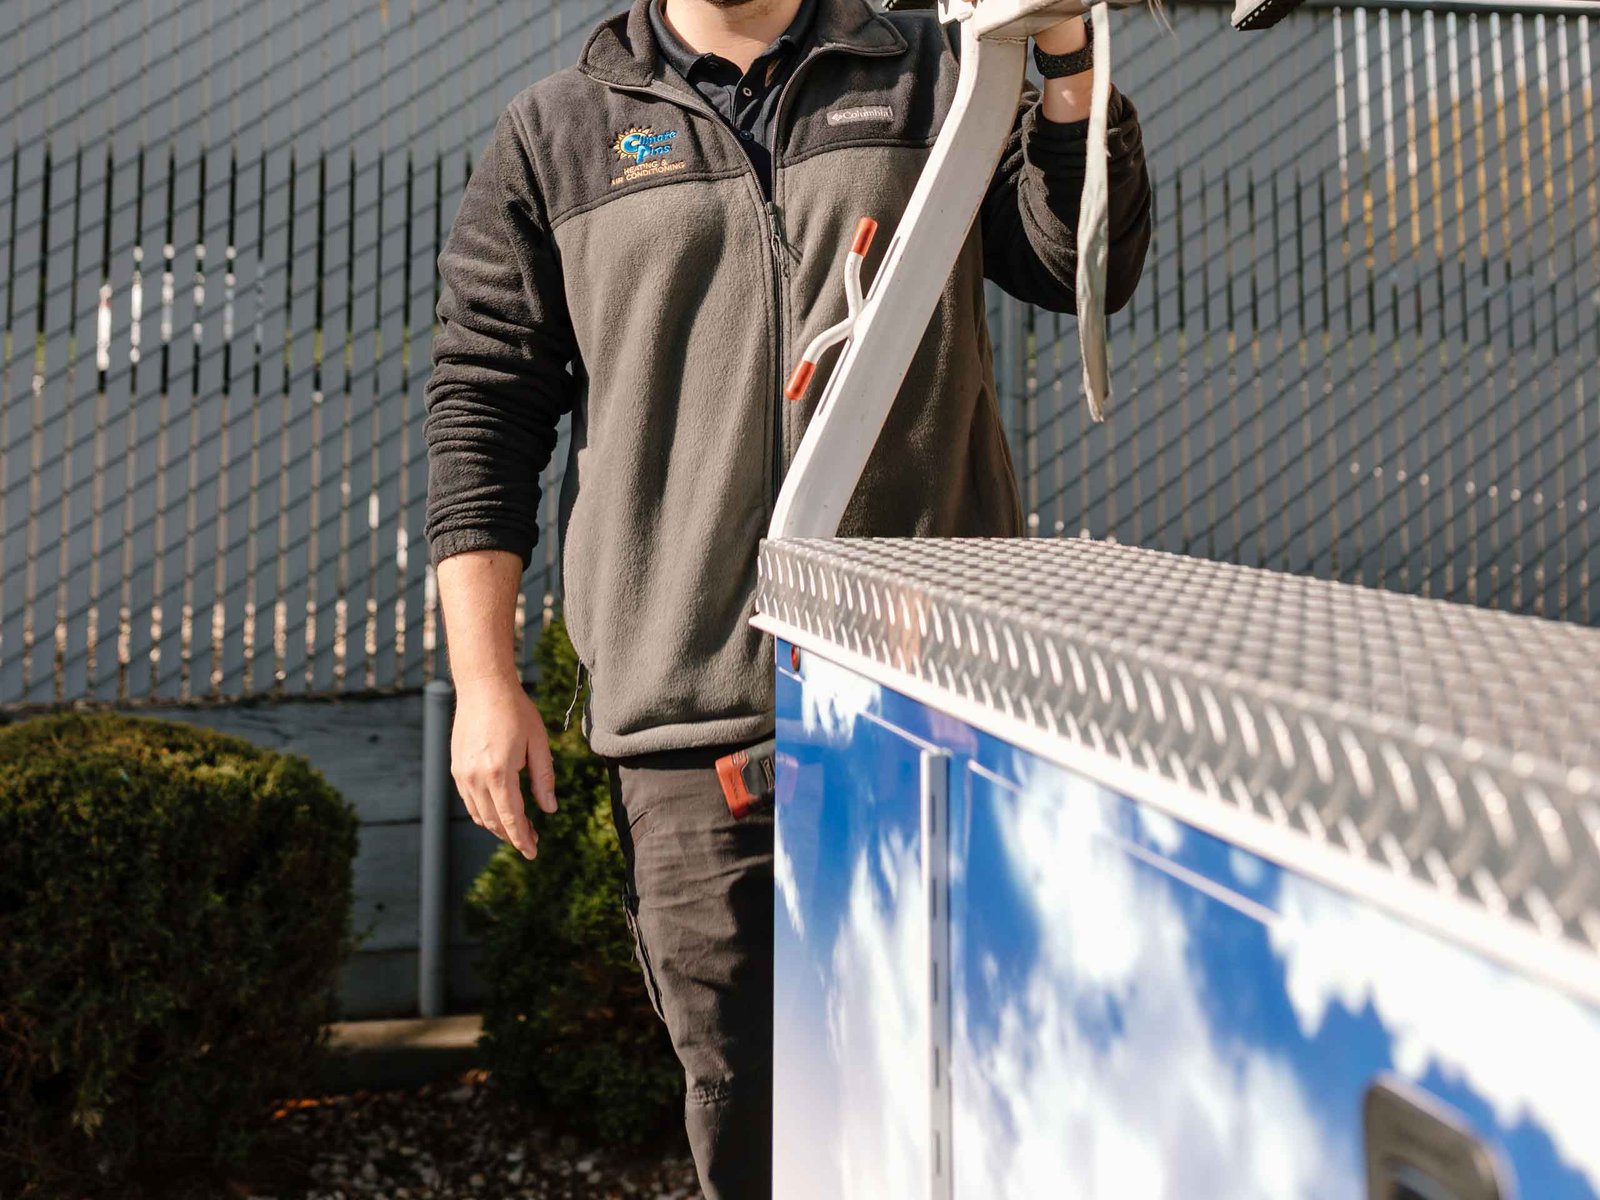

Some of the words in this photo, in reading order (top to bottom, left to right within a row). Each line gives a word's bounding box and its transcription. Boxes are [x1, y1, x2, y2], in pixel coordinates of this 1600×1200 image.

[843, 110, 889, 119] Columbia
[636, 145, 672, 164] Pros
[611, 176, 624, 186] AIR
[626, 161, 686, 181] CONDITIONING
[624, 160, 659, 175] HEATING
